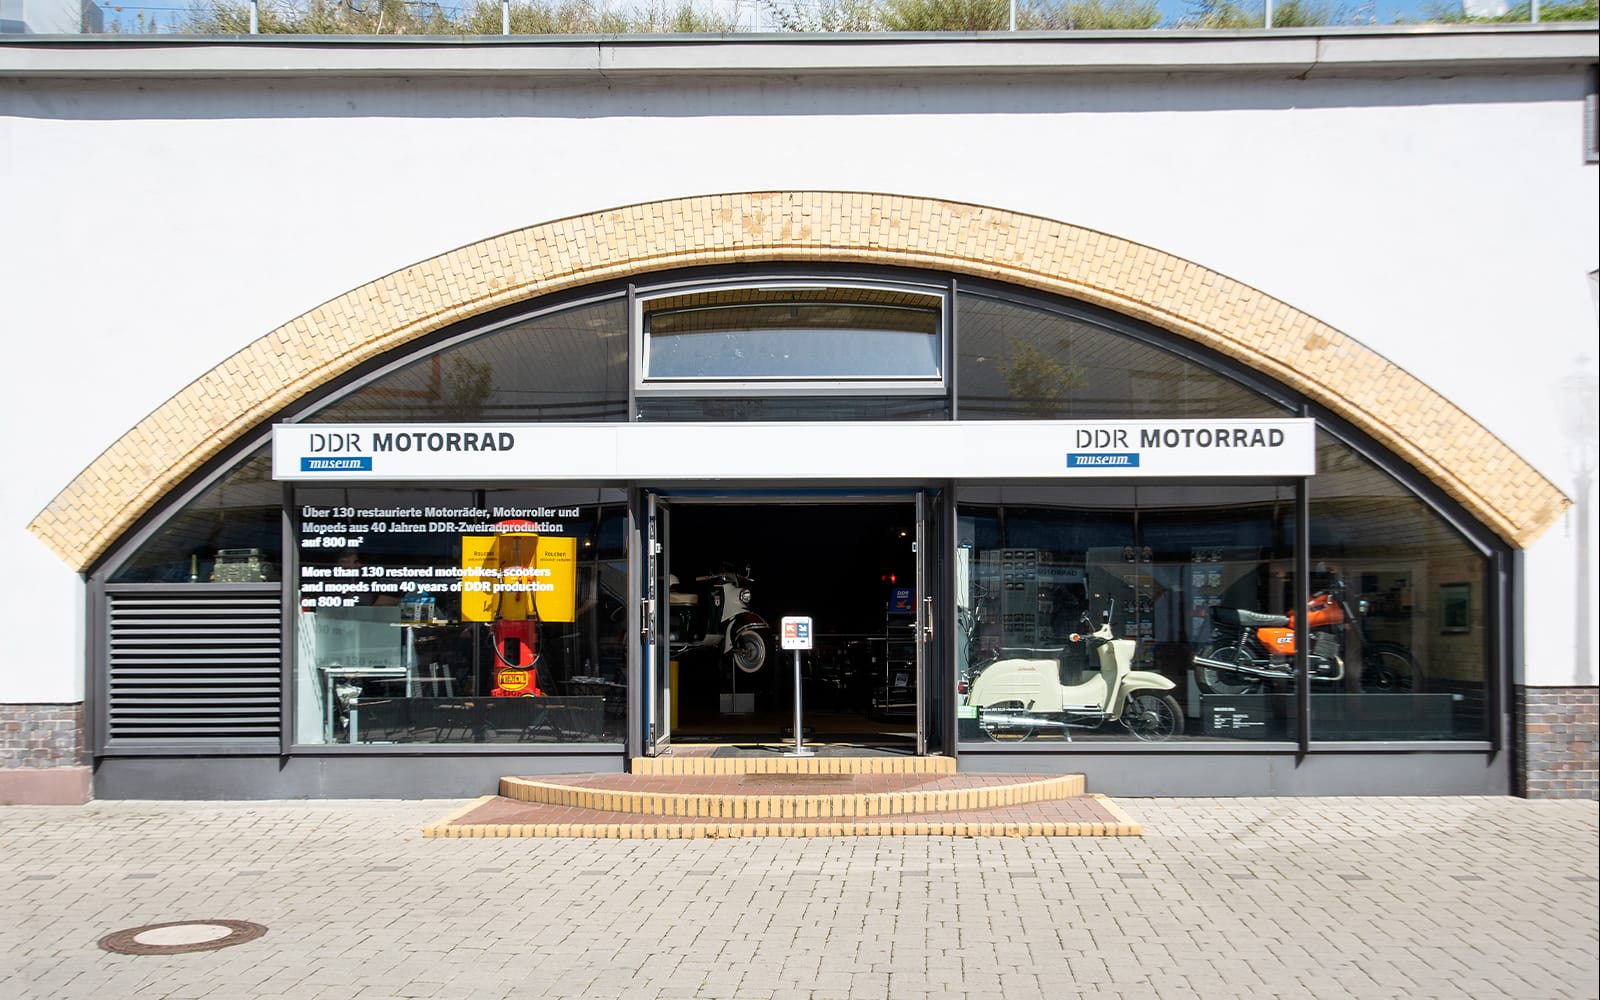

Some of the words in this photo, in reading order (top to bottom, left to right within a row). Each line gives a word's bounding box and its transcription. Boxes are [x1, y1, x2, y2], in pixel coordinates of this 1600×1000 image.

[310, 433, 362, 453] DDR
[373, 432, 515, 452] MOTORRAD
[1076, 429, 1129, 449] DDR
[1140, 428, 1284, 448] MOTORRAD
[309, 459, 363, 470] museum
[1075, 455, 1131, 465] museum
[302, 505, 331, 518] Über
[333, 507, 355, 518] 130
[357, 507, 422, 518] restaurierte
[424, 507, 491, 519] Motorräder,
[493, 507, 556, 518] Motorroller
[558, 507, 580, 518] und
[302, 522, 347, 534] Mopeds
[349, 524, 369, 533] aus
[371, 522, 387, 533] 40
[390, 522, 427, 533] Jahren
[429, 522, 563, 534] DDR-Zweiradproduktion
[302, 536, 322, 547] auf
[323, 536, 346, 547] 800
[302, 566, 332, 577] More
[334, 566, 359, 577] than
[361, 566, 384, 577] 130
[386, 566, 433, 577] restored
[435, 566, 501, 578] motorbikes,
[503, 567, 551, 577] scooters
[302, 581, 323, 592] and
[325, 581, 370, 594] mopeds
[371, 581, 398, 592] from
[399, 581, 416, 592] 40
[417, 583, 449, 594] years
[450, 581, 463, 592] of
[464, 581, 492, 592] DDR
[493, 581, 555, 593] production
[301, 598, 317, 607] on
[318, 596, 342, 607] 800
